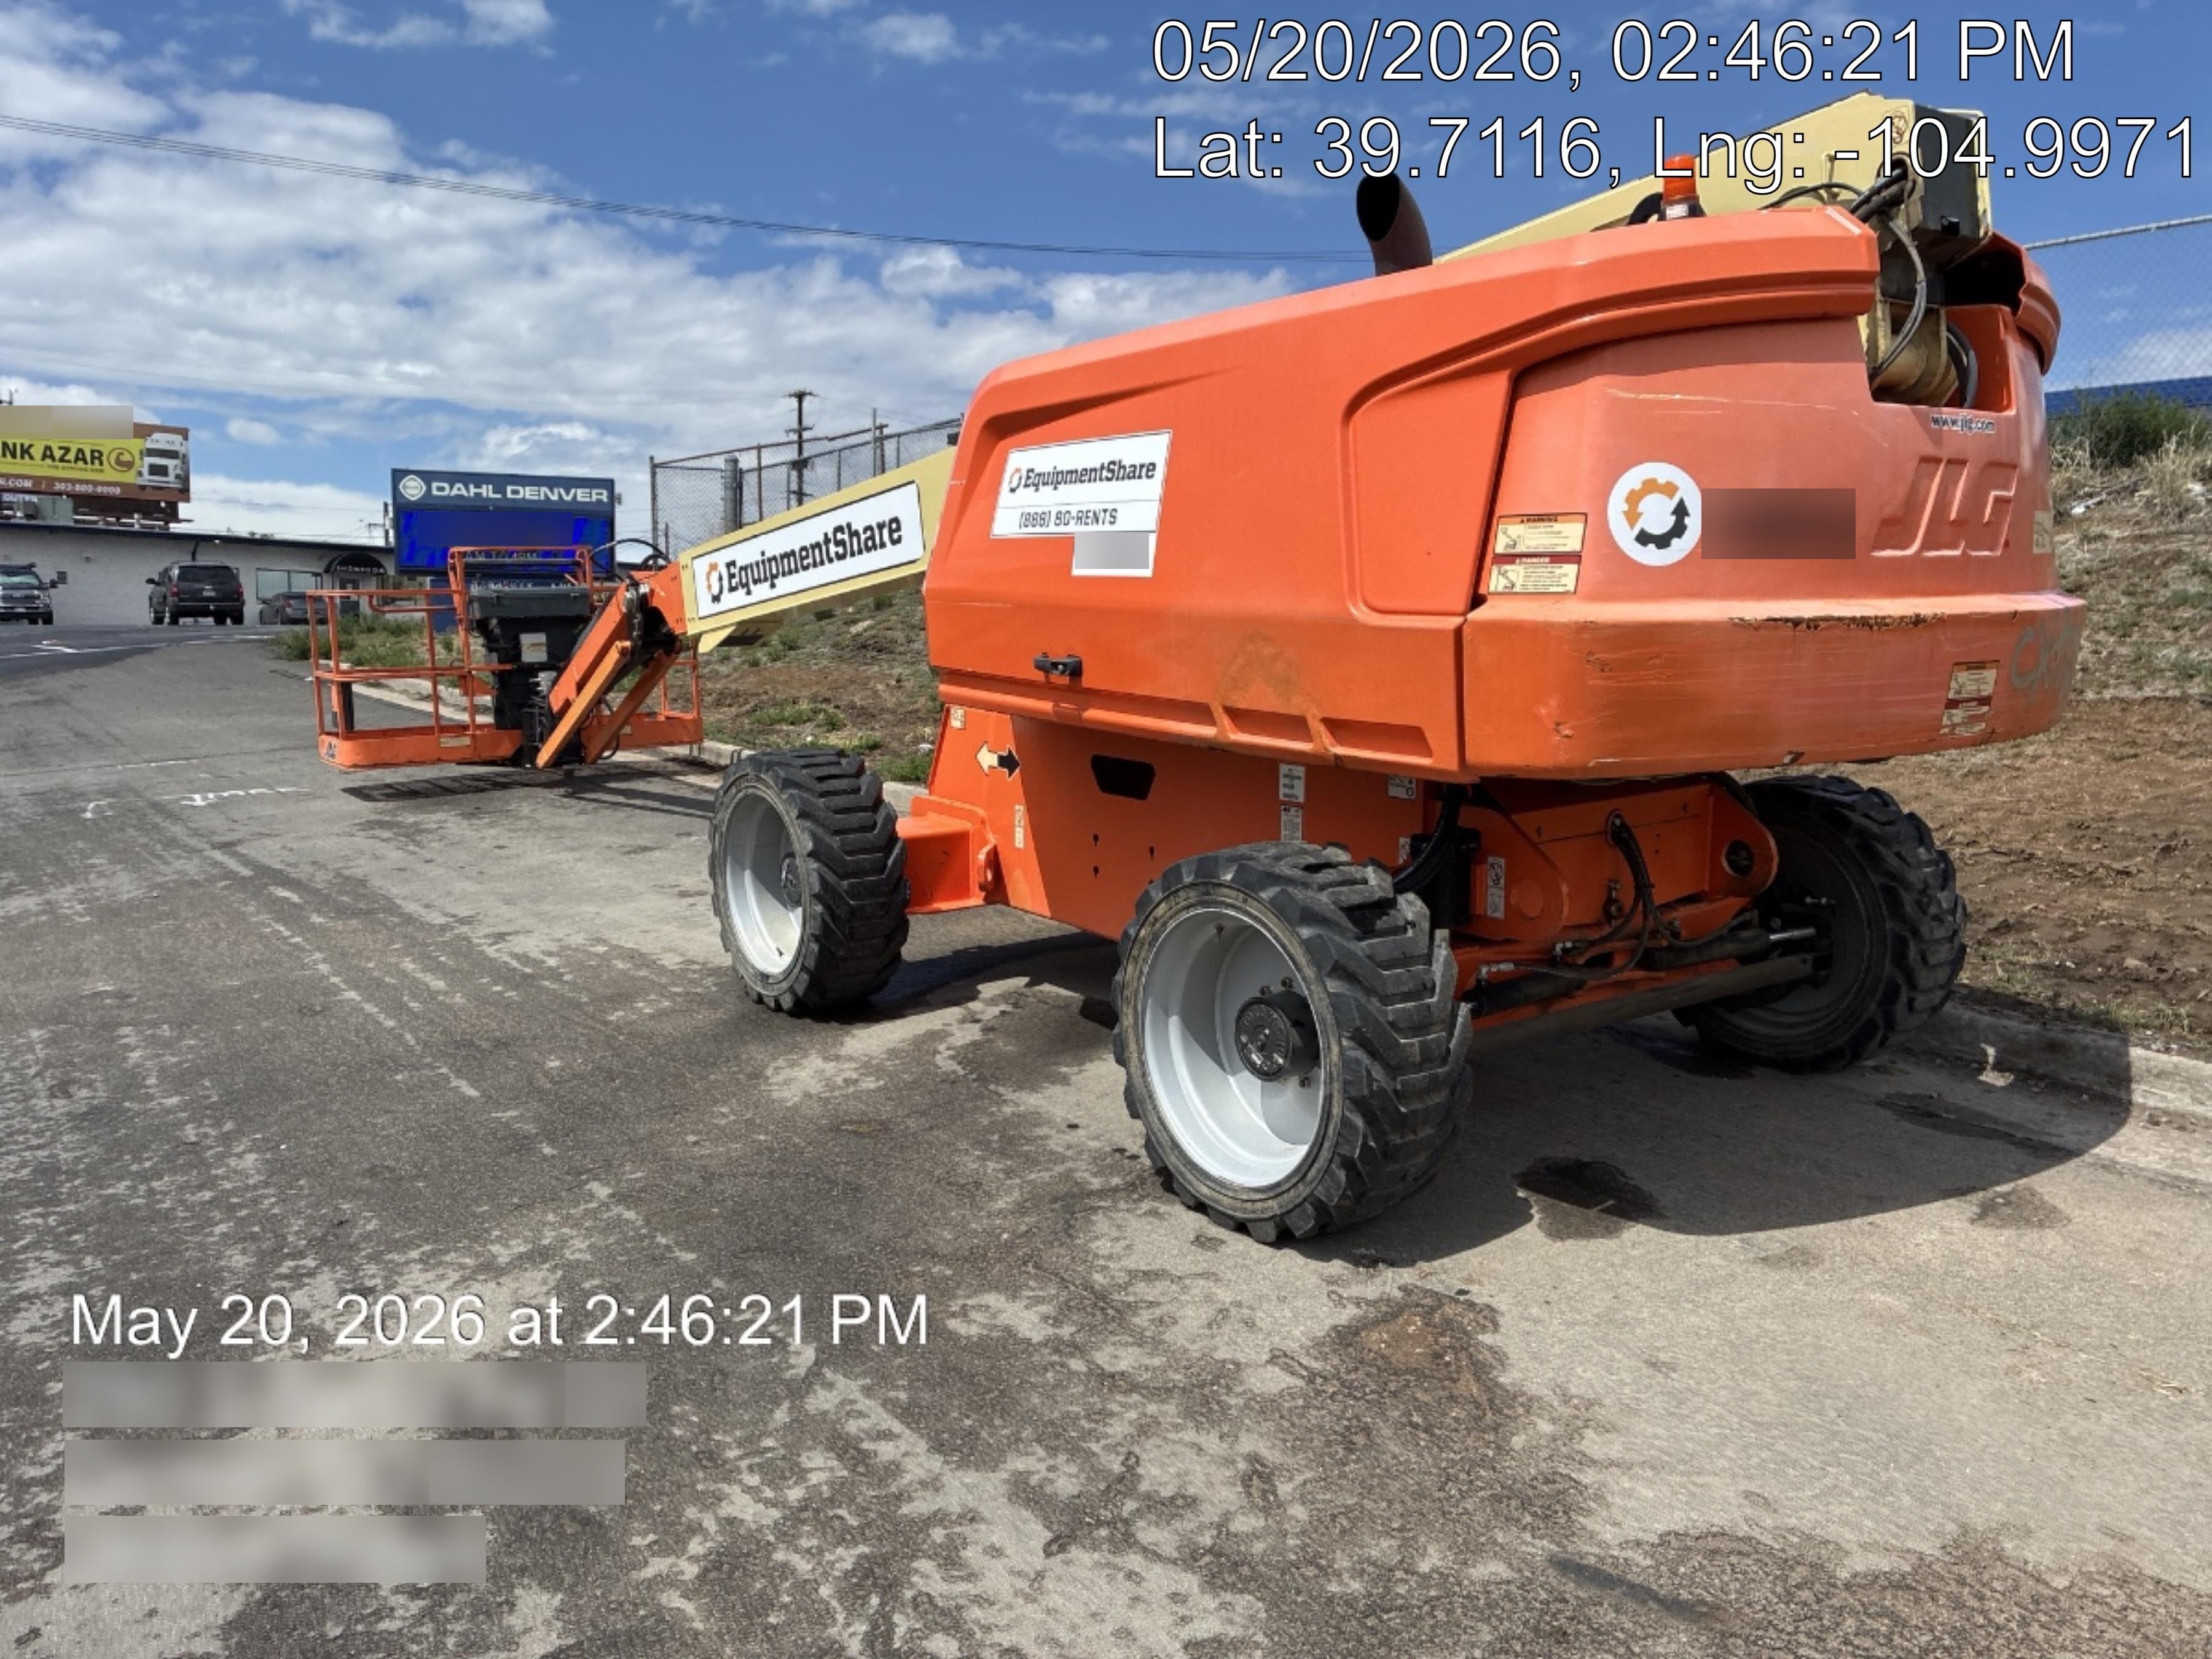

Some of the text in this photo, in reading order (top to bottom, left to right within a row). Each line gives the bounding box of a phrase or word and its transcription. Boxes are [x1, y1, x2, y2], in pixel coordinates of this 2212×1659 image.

[1931, 415, 1995, 434] www.jlg.com
[41, 444, 104, 467] AZAR
[1023, 459, 1157, 492] EquipmentShare
[431, 482, 608, 503] DAHL DENVER
[1054, 508, 1118, 527] 80-RENTS
[1870, 455, 2020, 557] JLG
[725, 515, 903, 595] EquipmentShare
